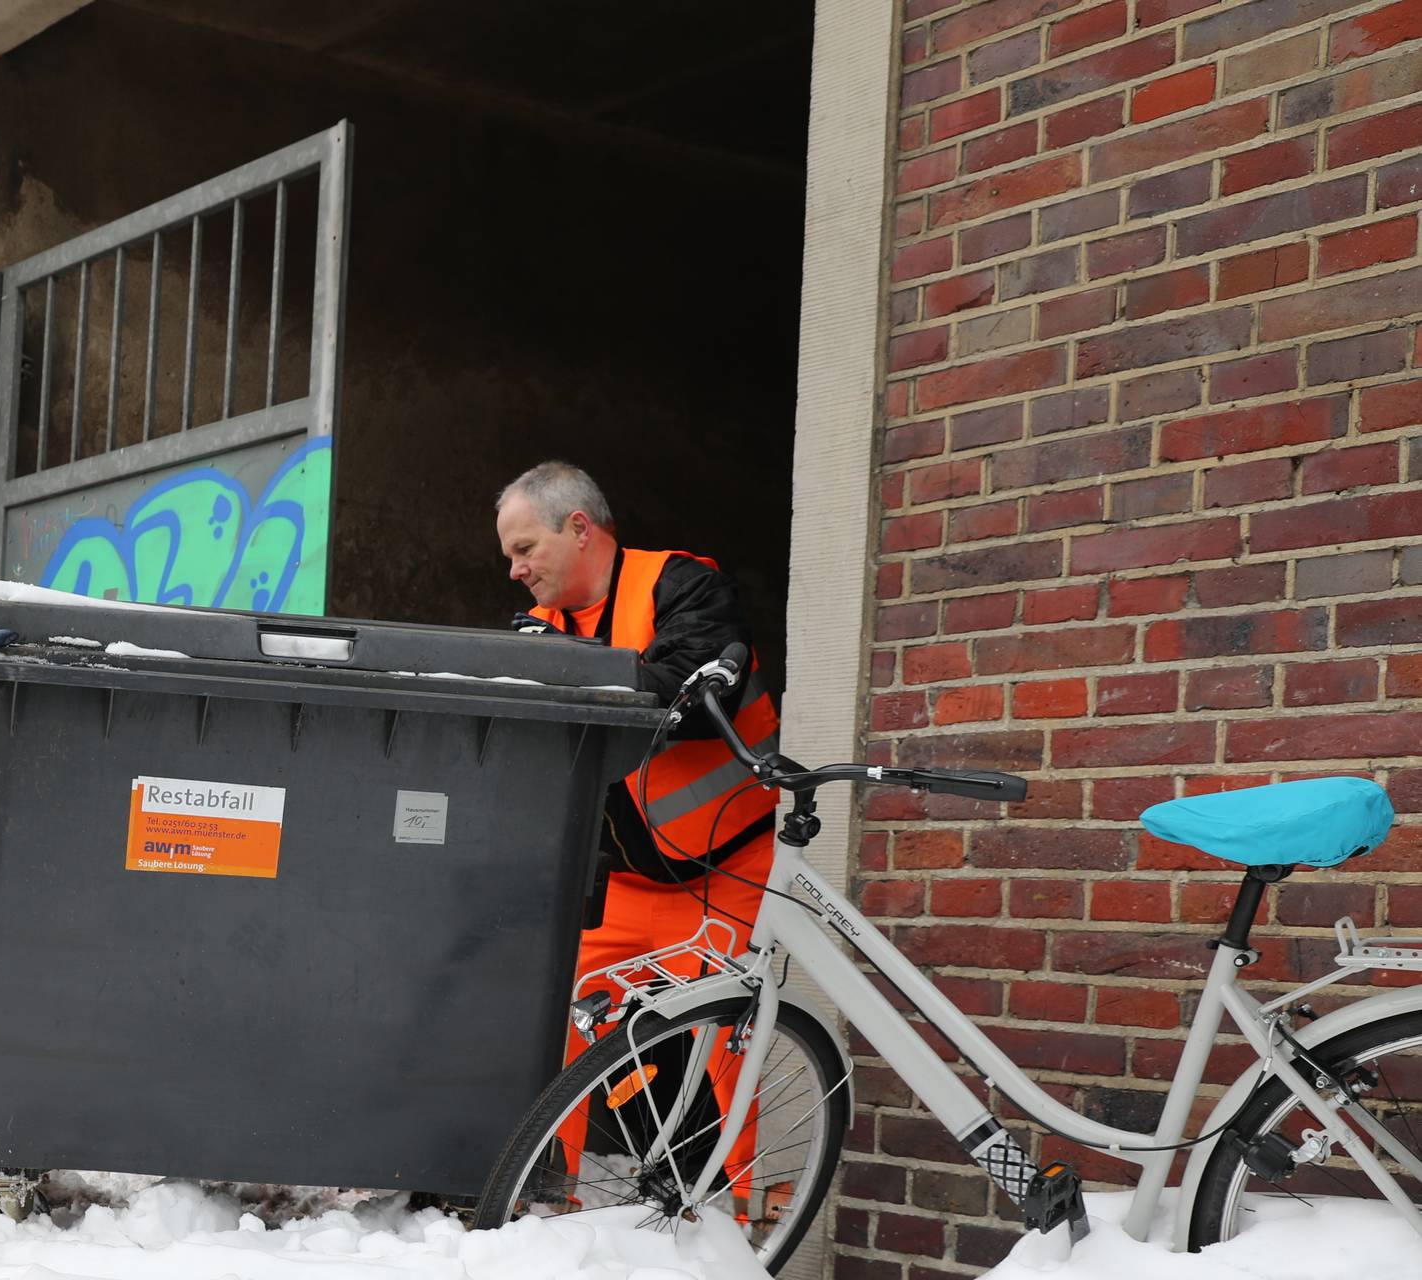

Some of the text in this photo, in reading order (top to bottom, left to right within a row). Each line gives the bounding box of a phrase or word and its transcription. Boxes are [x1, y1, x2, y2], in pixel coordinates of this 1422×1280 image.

[148, 785, 255, 812] Restabfall
[147, 816, 219, 832] Tel. 0251/60 52 53
[144, 840, 191, 857] awm
[191, 851, 213, 859] Lösung
[192, 844, 216, 853] Saubere
[138, 858, 207, 873] Saubere Lösung.
[794, 873, 860, 936] COOLGREY
